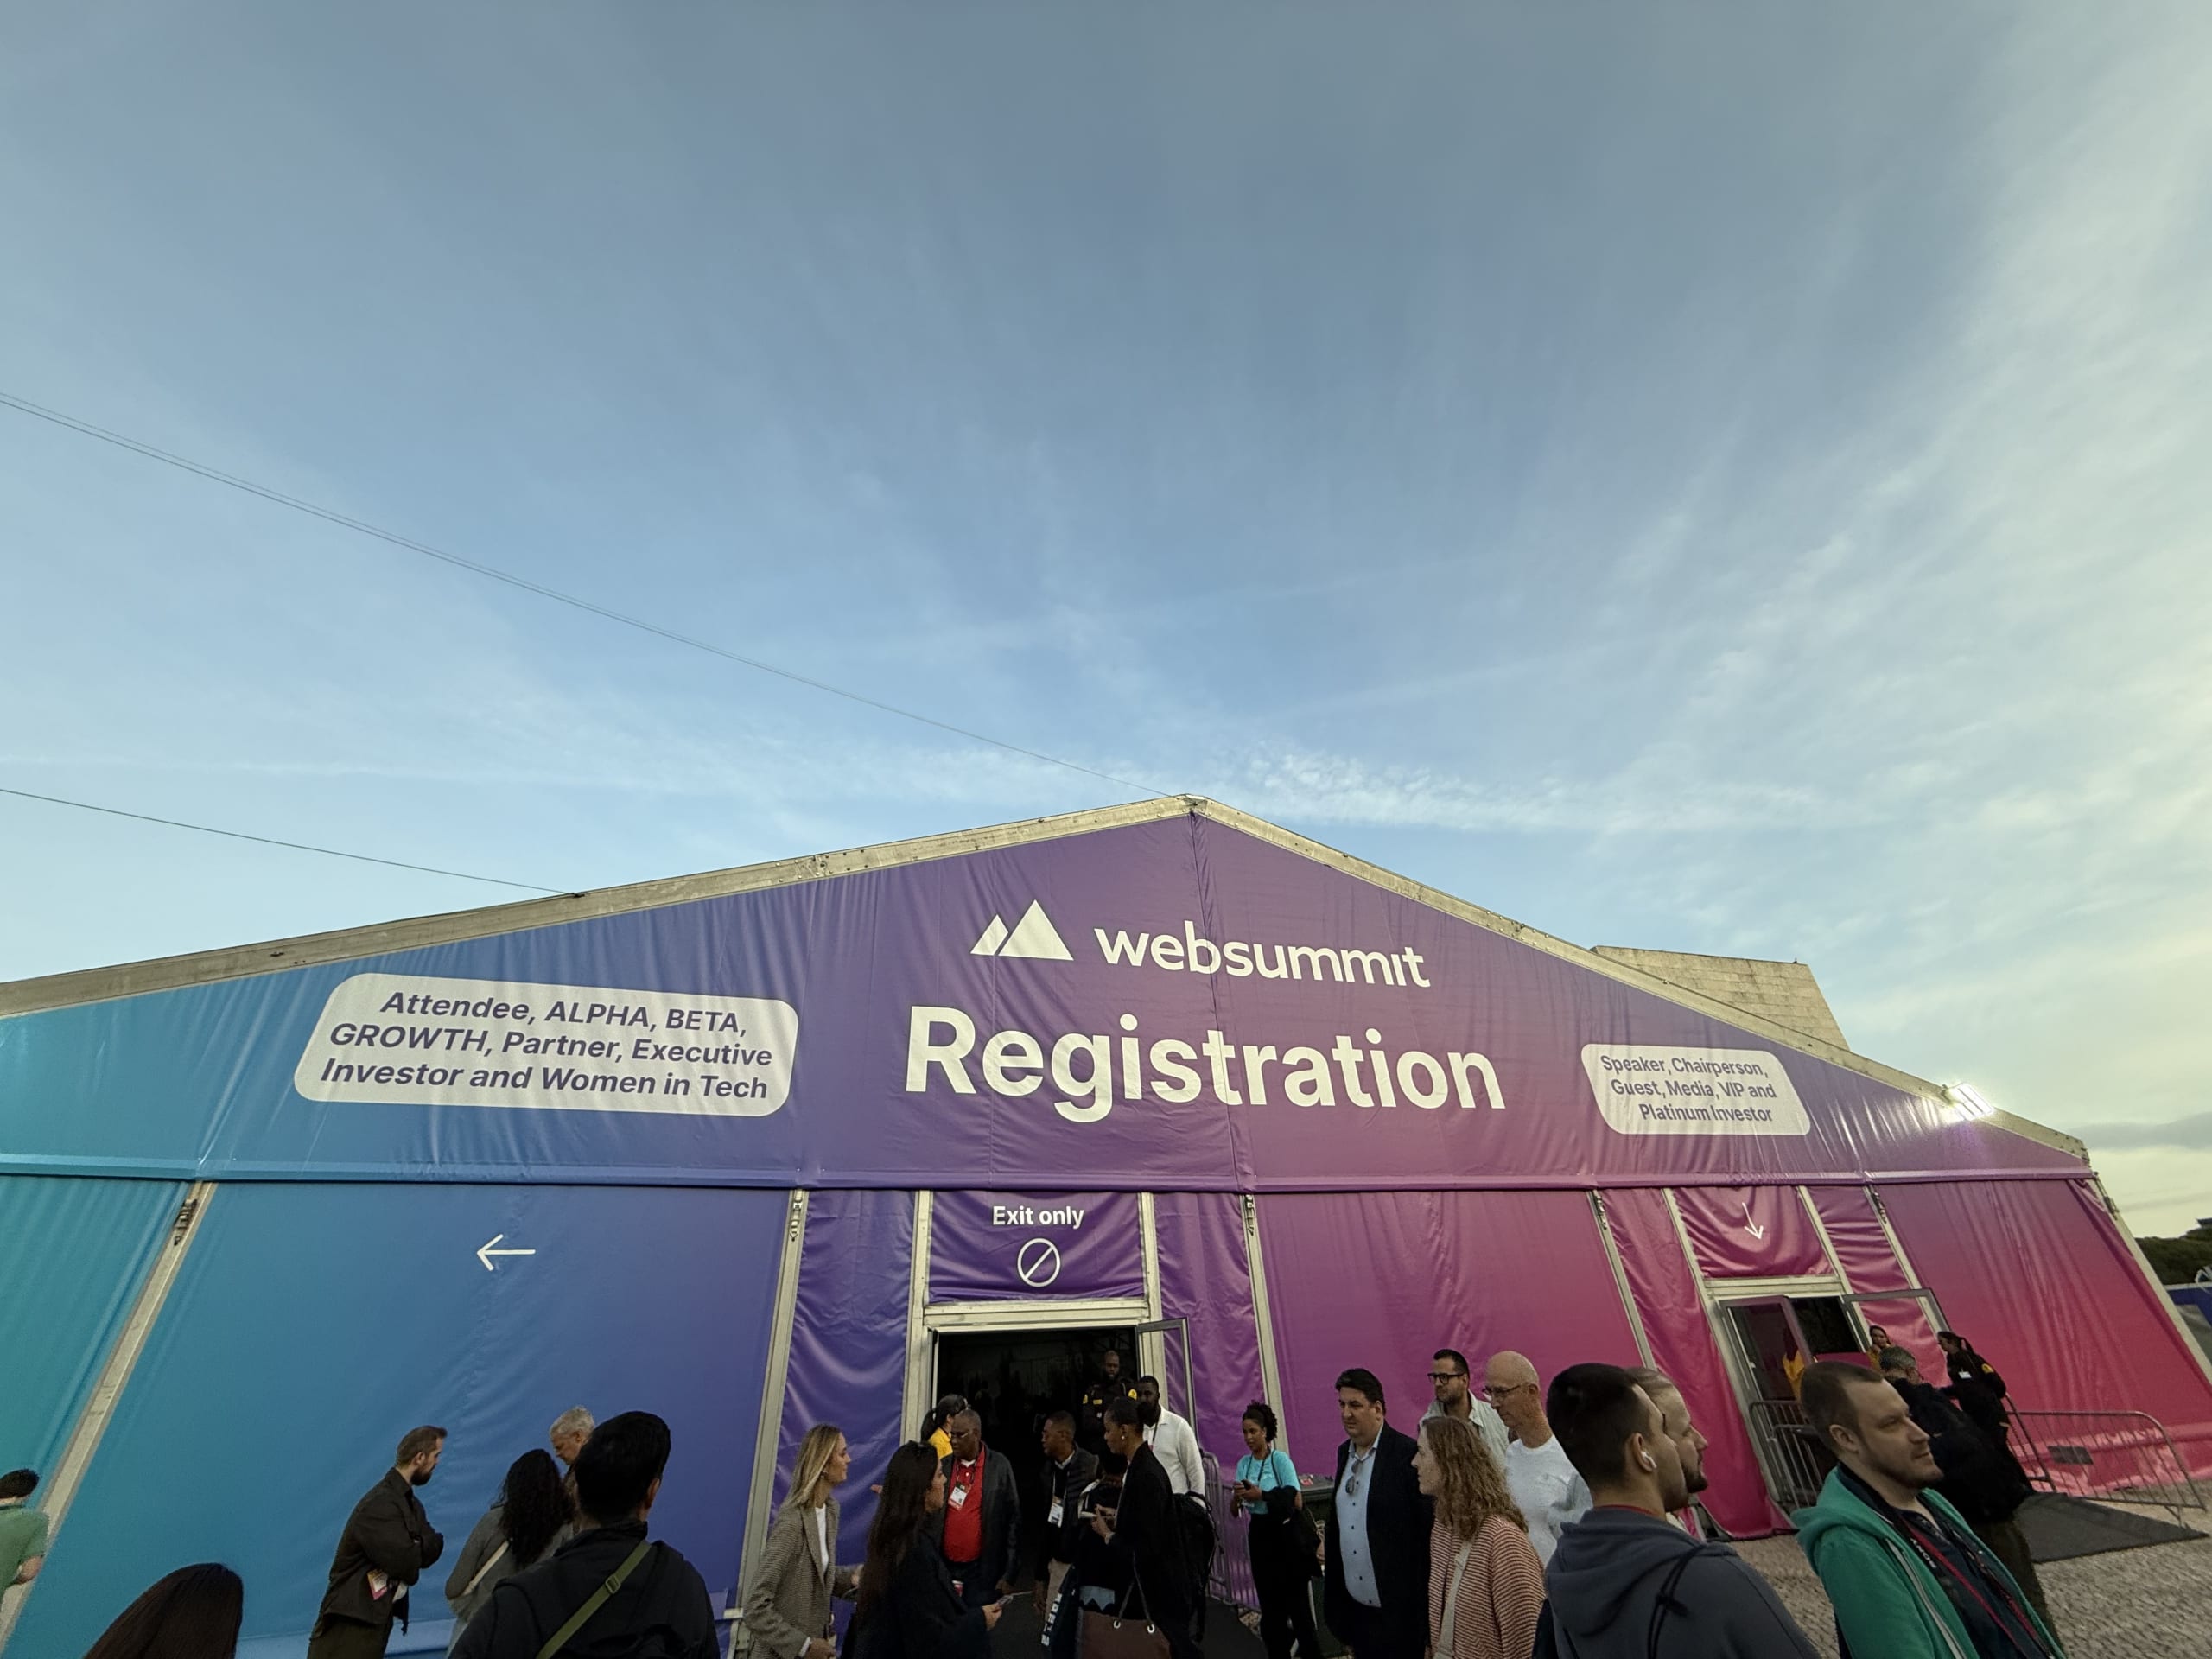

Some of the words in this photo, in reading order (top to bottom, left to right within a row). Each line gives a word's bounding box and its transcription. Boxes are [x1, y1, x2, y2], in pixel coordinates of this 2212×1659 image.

[1094, 919, 1431, 988] websummit
[380, 991, 537, 1025] Attendee,
[544, 1001, 658, 1032] ALPHA,
[665, 1008, 747, 1037] BETA,
[328, 1023, 493, 1058] GROWTH,
[502, 1032, 625, 1063] Partner,
[631, 1039, 772, 1066] Executive
[906, 1005, 1505, 1122] Registration
[320, 1058, 464, 1087] Investor
[469, 1066, 531, 1090] and
[541, 1071, 657, 1094] Women
[663, 1073, 690, 1096] in
[699, 1075, 768, 1099] Tech
[1600, 1055, 1672, 1075] Speaker,
[1671, 1058, 1768, 1078] Chairperson,
[1611, 1079, 1666, 1099] Guest,
[1666, 1080, 1720, 1100] Media,
[1718, 1082, 1745, 1098] VIP
[1748, 1084, 1777, 1098] and
[1638, 1103, 1714, 1121] Platinum
[1712, 1106, 1772, 1122] Investor
[993, 1205, 1033, 1225] Exit
[1039, 1205, 1084, 1230] only
